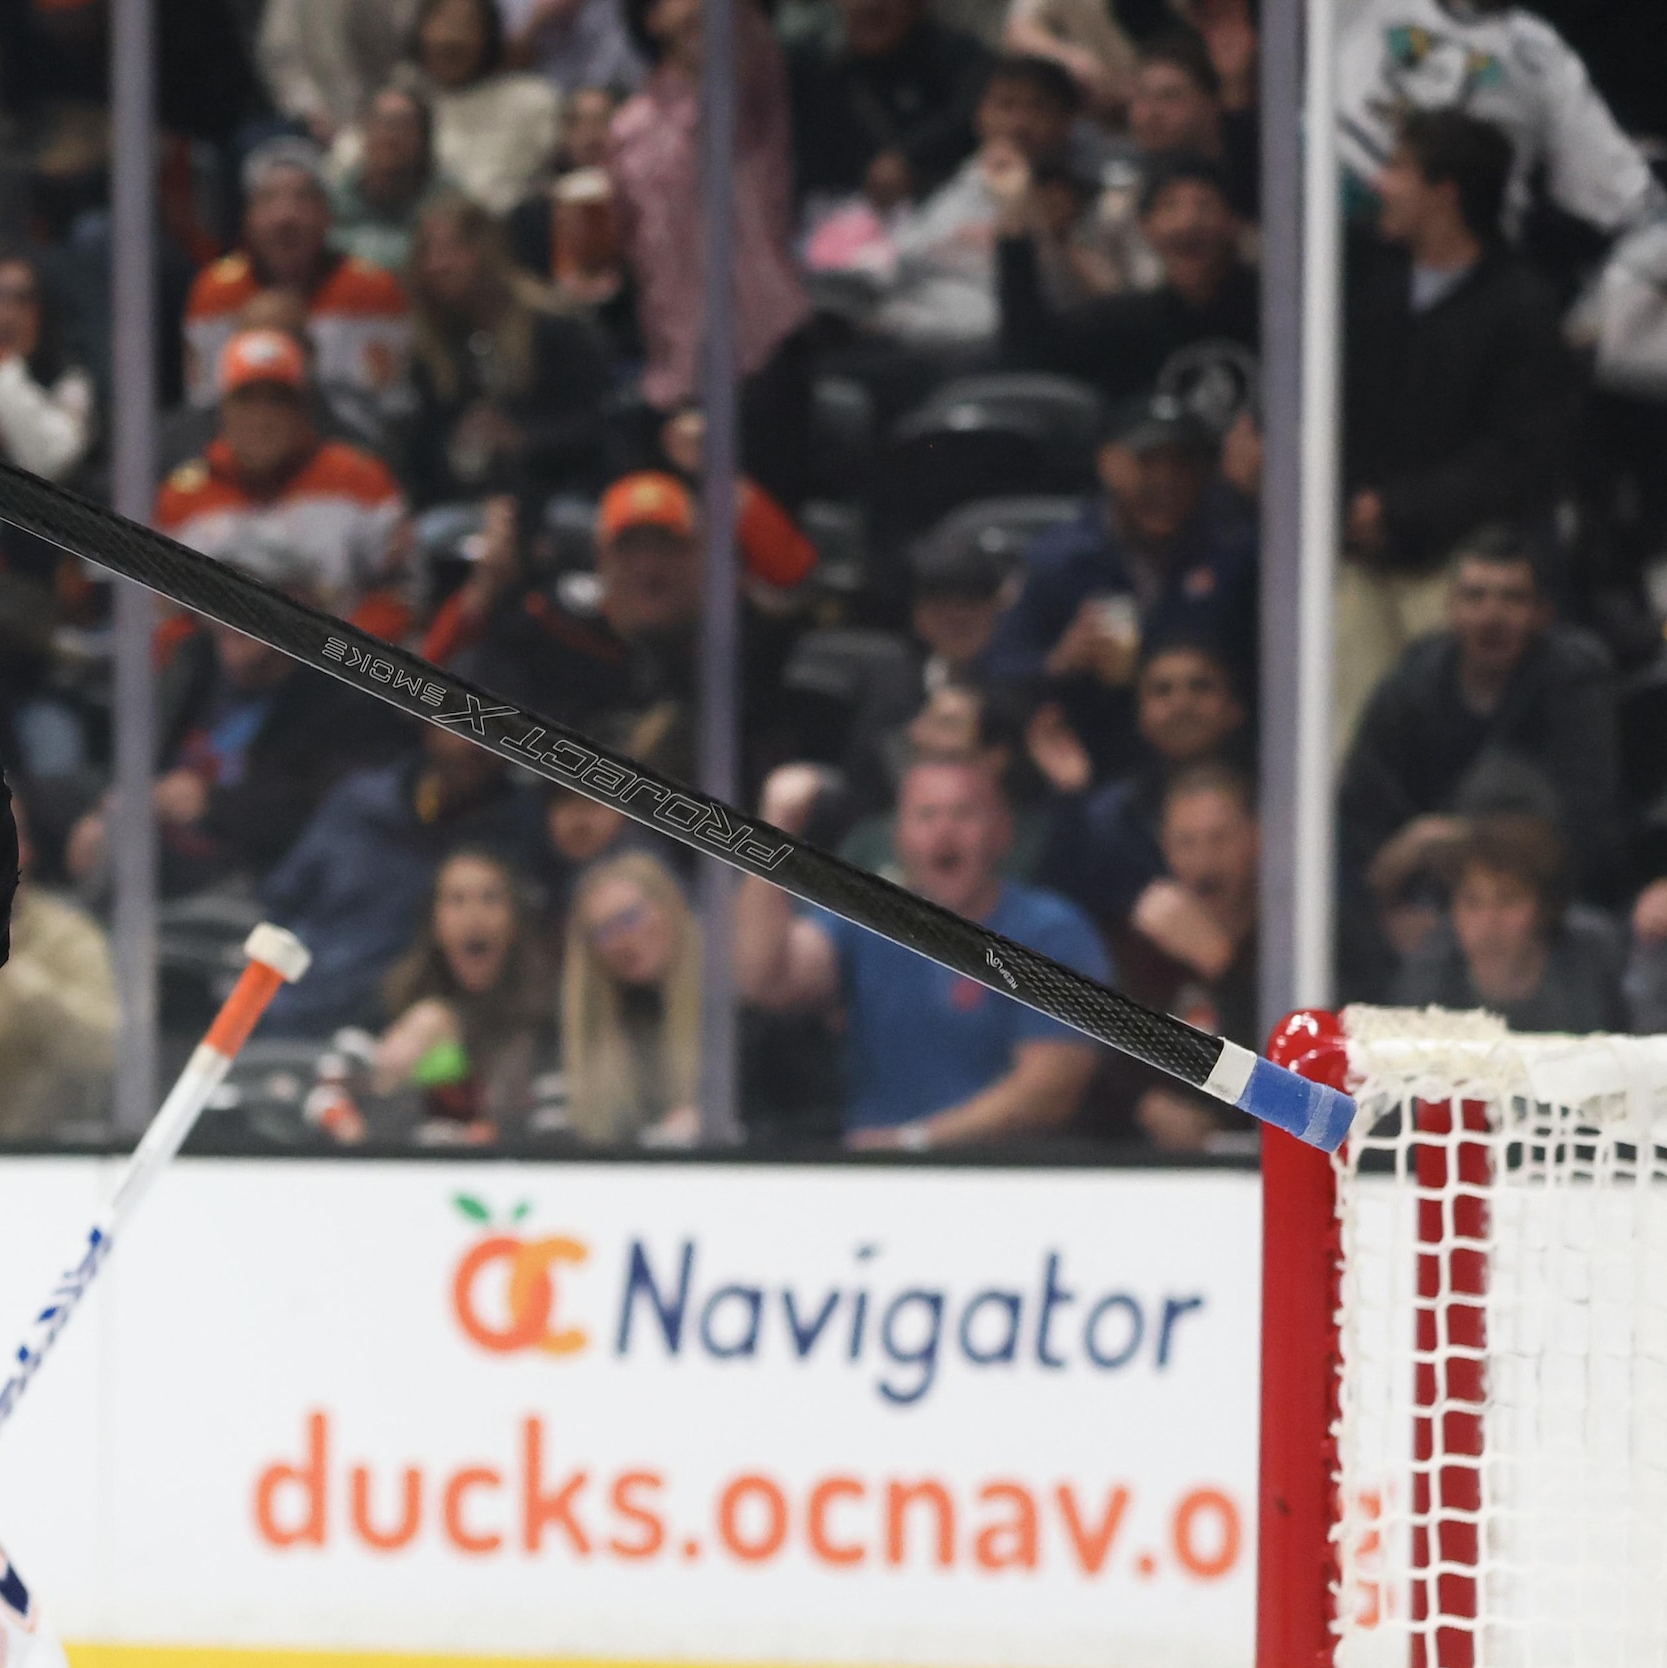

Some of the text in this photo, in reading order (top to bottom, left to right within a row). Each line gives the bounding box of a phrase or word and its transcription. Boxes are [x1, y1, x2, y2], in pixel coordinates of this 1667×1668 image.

[322, 635, 448, 708] SMOKE
[432, 694, 520, 735] X
[617, 1238, 1205, 1405] Navigator
